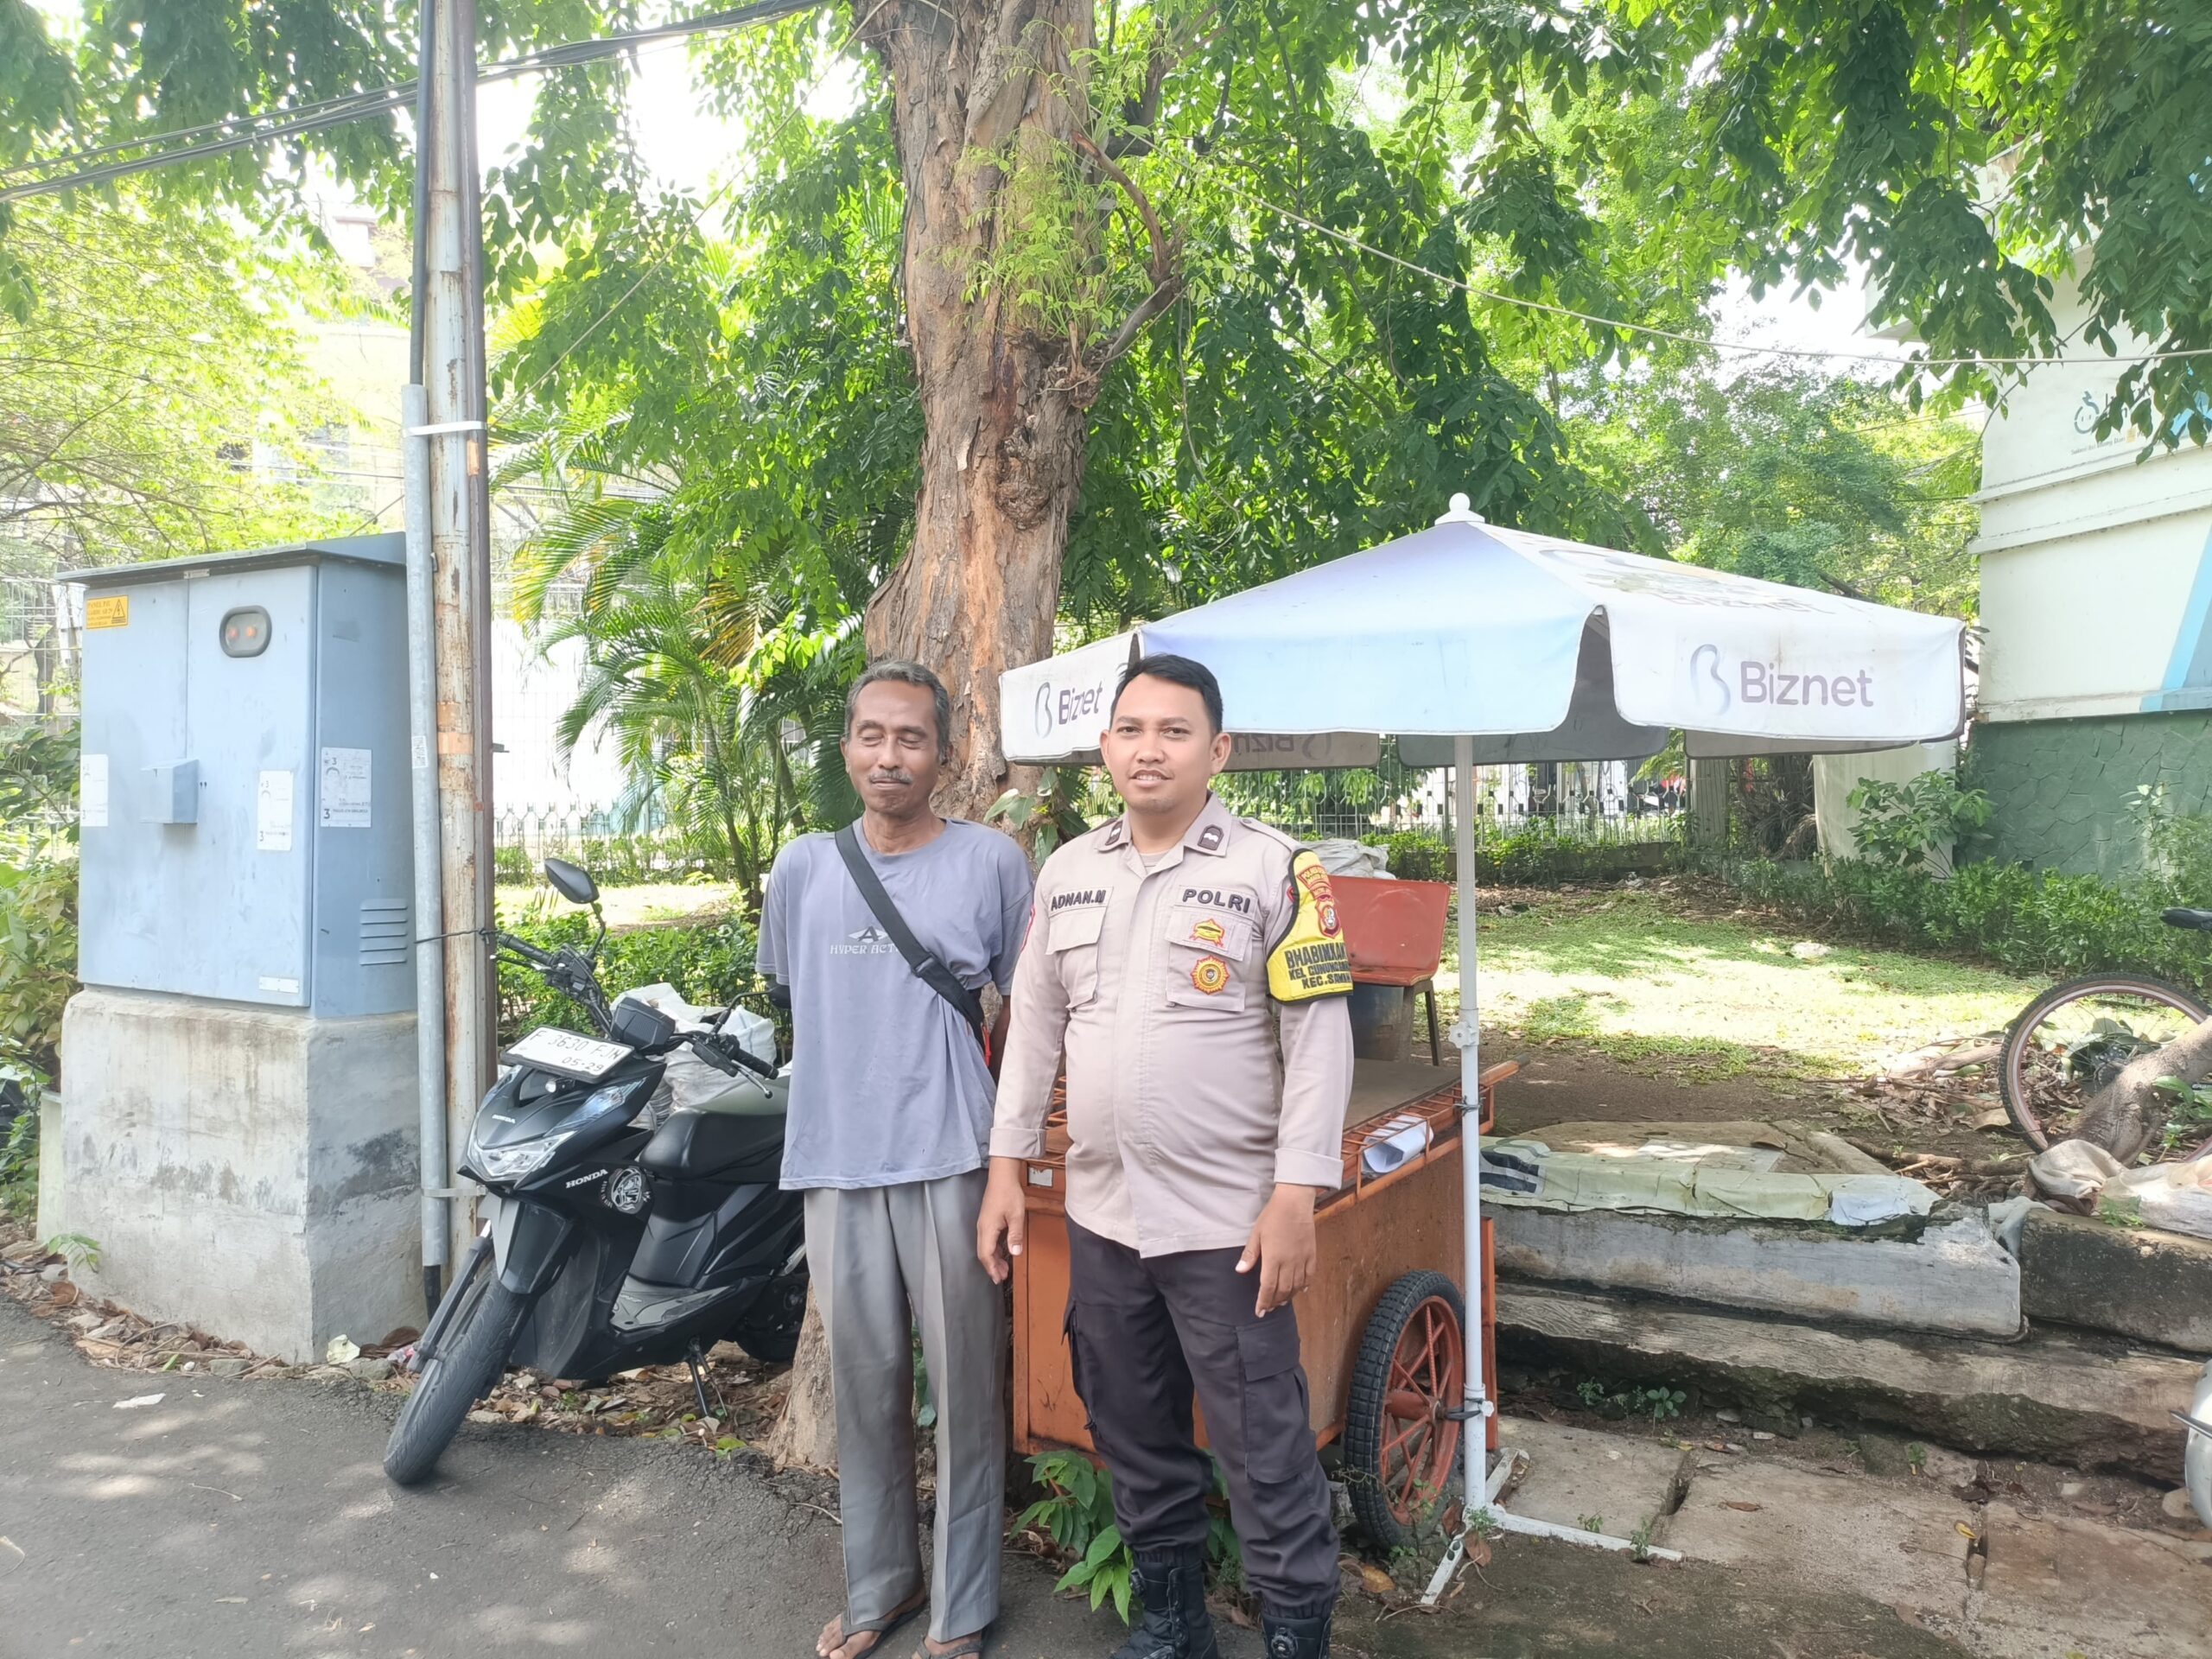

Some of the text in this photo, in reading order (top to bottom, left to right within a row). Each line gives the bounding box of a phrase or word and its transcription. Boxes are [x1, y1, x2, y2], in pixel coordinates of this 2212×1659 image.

[1740, 661, 1874, 708] Biznet
[323, 808, 330, 819] 3
[1182, 888, 1251, 913] POLRI
[830, 944, 868, 955] HYPER
[529, 1030, 546, 1041] F
[548, 1034, 589, 1052] 3630
[566, 1167, 609, 1189] HONDA
